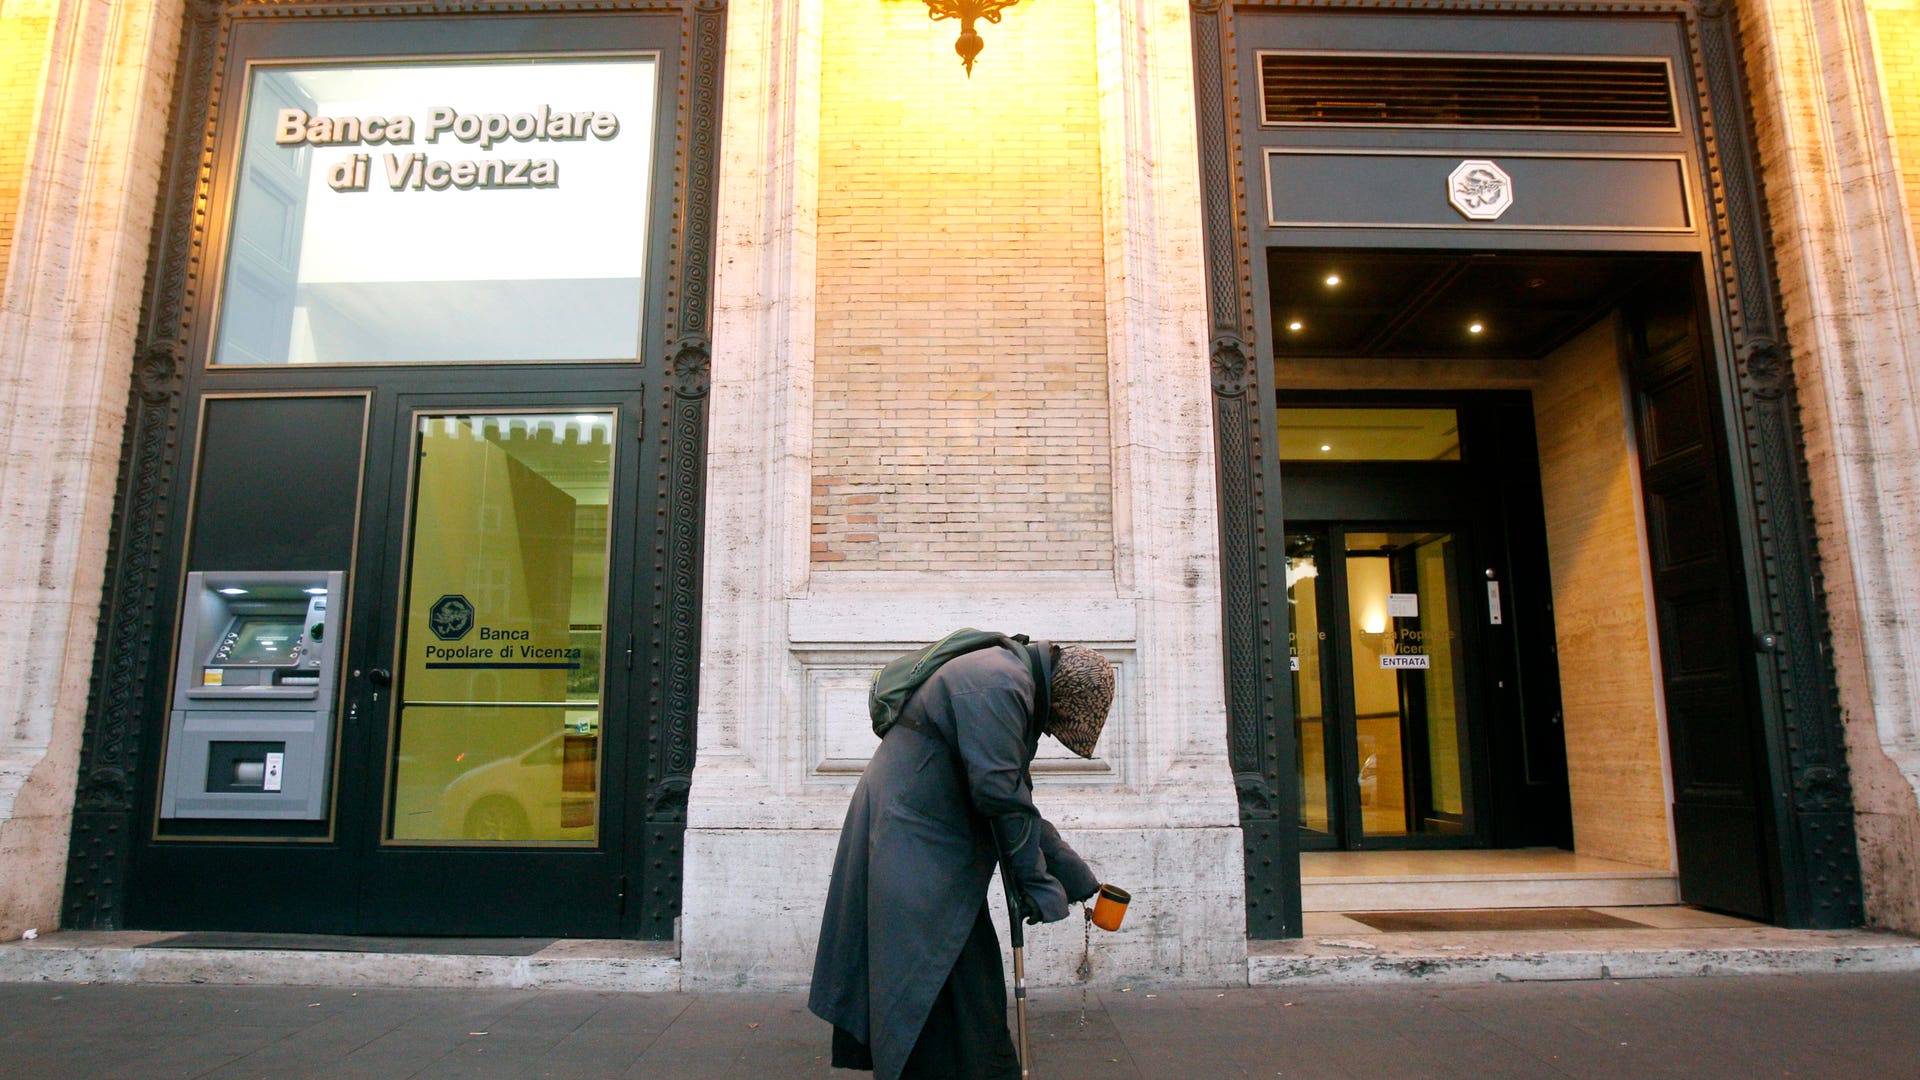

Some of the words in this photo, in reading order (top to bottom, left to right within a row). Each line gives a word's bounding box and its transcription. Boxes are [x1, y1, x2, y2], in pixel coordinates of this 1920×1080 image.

[276, 108, 414, 146] Banca
[425, 104, 618, 149] Popolare
[327, 154, 370, 191] di
[383, 153, 558, 190] Vicenza
[480, 628, 529, 640] Banca
[1359, 629, 1397, 639] Bca
[426, 645, 493, 661] Popolare
[500, 645, 513, 658] di
[520, 646, 581, 658] Vicenza
[1382, 658, 1426, 666] ENTRATA
